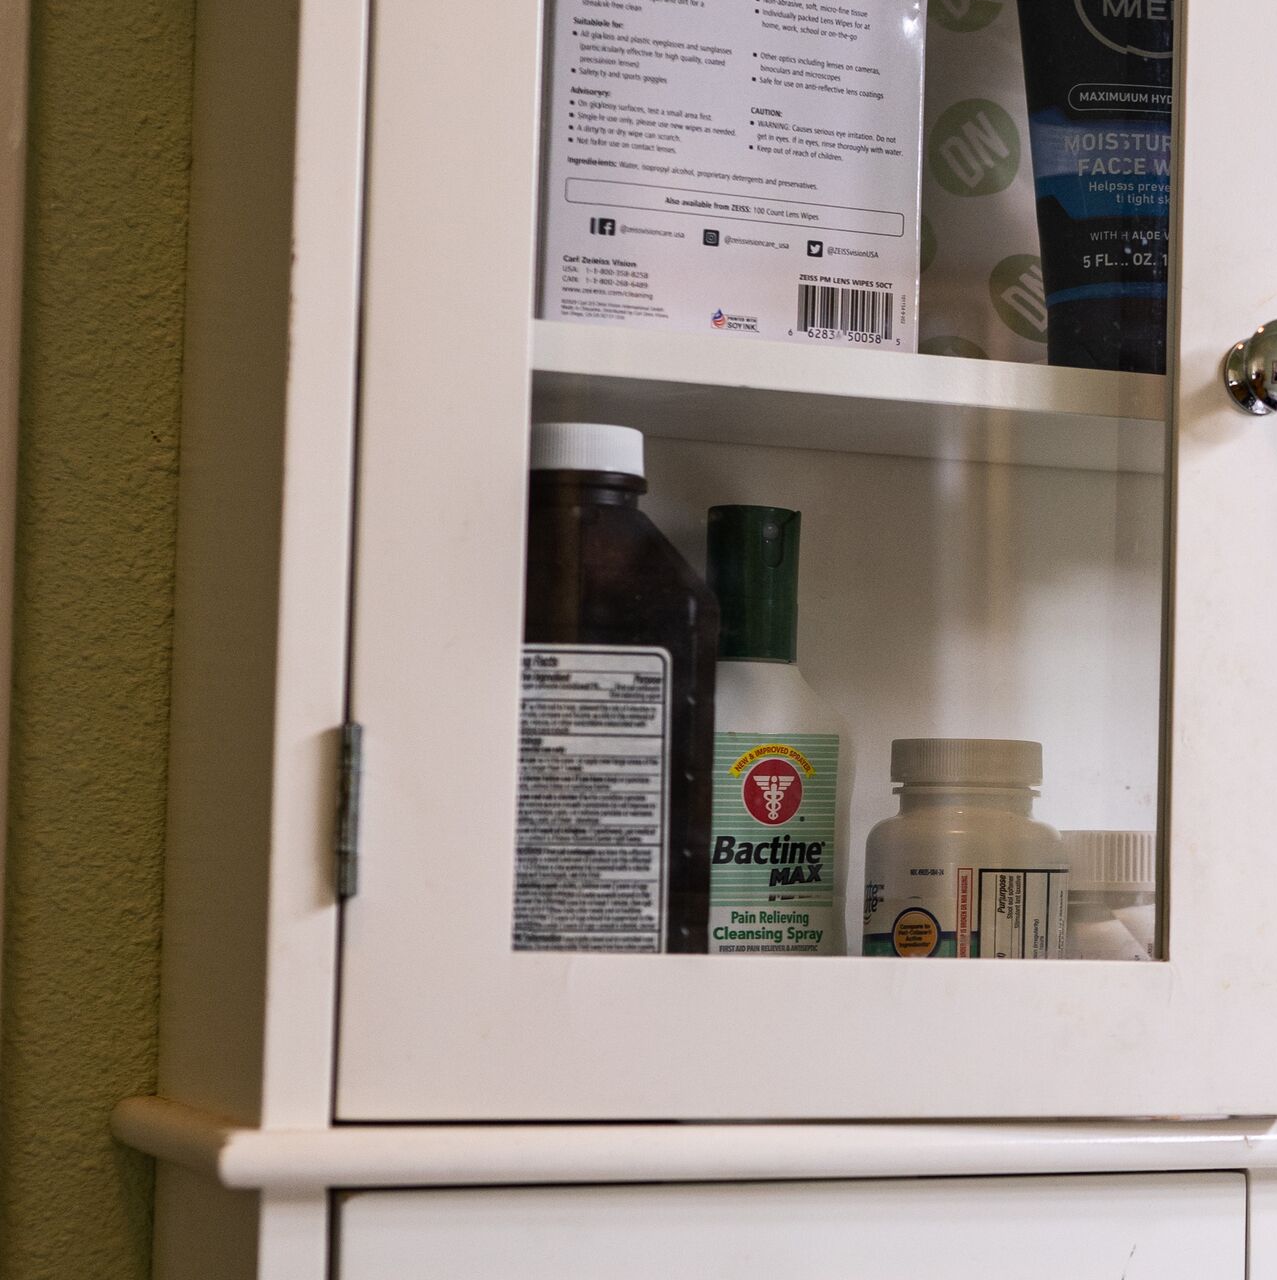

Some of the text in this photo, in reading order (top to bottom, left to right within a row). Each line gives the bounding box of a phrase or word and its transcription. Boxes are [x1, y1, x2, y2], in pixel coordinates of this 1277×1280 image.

[820, 5, 849, 15] micro-fine
[763, 9, 796, 21] Individually
[798, 14, 819, 23] packed
[820, 17, 833, 25] Lens
[835, 19, 852, 28] Wipes
[854, 21, 862, 29] for
[762, 21, 781, 30] home,
[782, 24, 798, 33] work,
[829, 30, 857, 41] on-the-go
[760, 52, 777, 61] Other
[779, 55, 796, 63] optics
[798, 57, 825, 68] including
[826, 61, 844, 70] lenses
[855, 66, 880, 75] cameras,
[760, 65, 790, 74] binoculars
[805, 71, 840, 82] microscopes
[759, 77, 773, 85] Safe
[805, 83, 844, 94] anti-reflective
[859, 90, 883, 100] coatings
[751, 107, 782, 117] CAUTION:
[792, 125, 812, 133] Causes
[814, 128, 834, 136] serious
[848, 131, 874, 141] irritation.
[757, 134, 767, 142] get
[776, 135, 789, 143] eyes.
[805, 139, 819, 147] eyes,
[837, 142, 869, 154] thoroughly
[757, 145, 772, 154] Keep
[793, 149, 809, 157] reach
[818, 152, 843, 161] children.
[778, 179, 818, 190] preservatives.
[665, 197, 680, 205] Also
[682, 199, 711, 209] available
[731, 204, 750, 213] ZEISS:
[767, 208, 784, 217] Count
[800, 212, 819, 221] Wipes
[1132, 231, 1160, 240] ALOE
[563, 255, 579, 263] Carl
[612, 259, 636, 268] Vision
[1083, 256, 1090, 268] 5
[1133, 253, 1156, 266] OZ.
[799, 274, 818, 282] ZEISS
[833, 277, 850, 285] LENS
[852, 279, 874, 288] WIPES
[875, 281, 893, 289] 50CT
[728, 322, 756, 331] SOY INK
[848, 332, 881, 344] 50058
[735, 758, 748, 772] NEW
[755, 746, 788, 757] IMPROVED
[789, 750, 811, 772] SPRAYER
[712, 834, 822, 864] Bactine
[769, 864, 823, 887] MAX
[731, 911, 809, 926] Pain Relieving
[713, 926, 823, 943] Cleansing Spray
